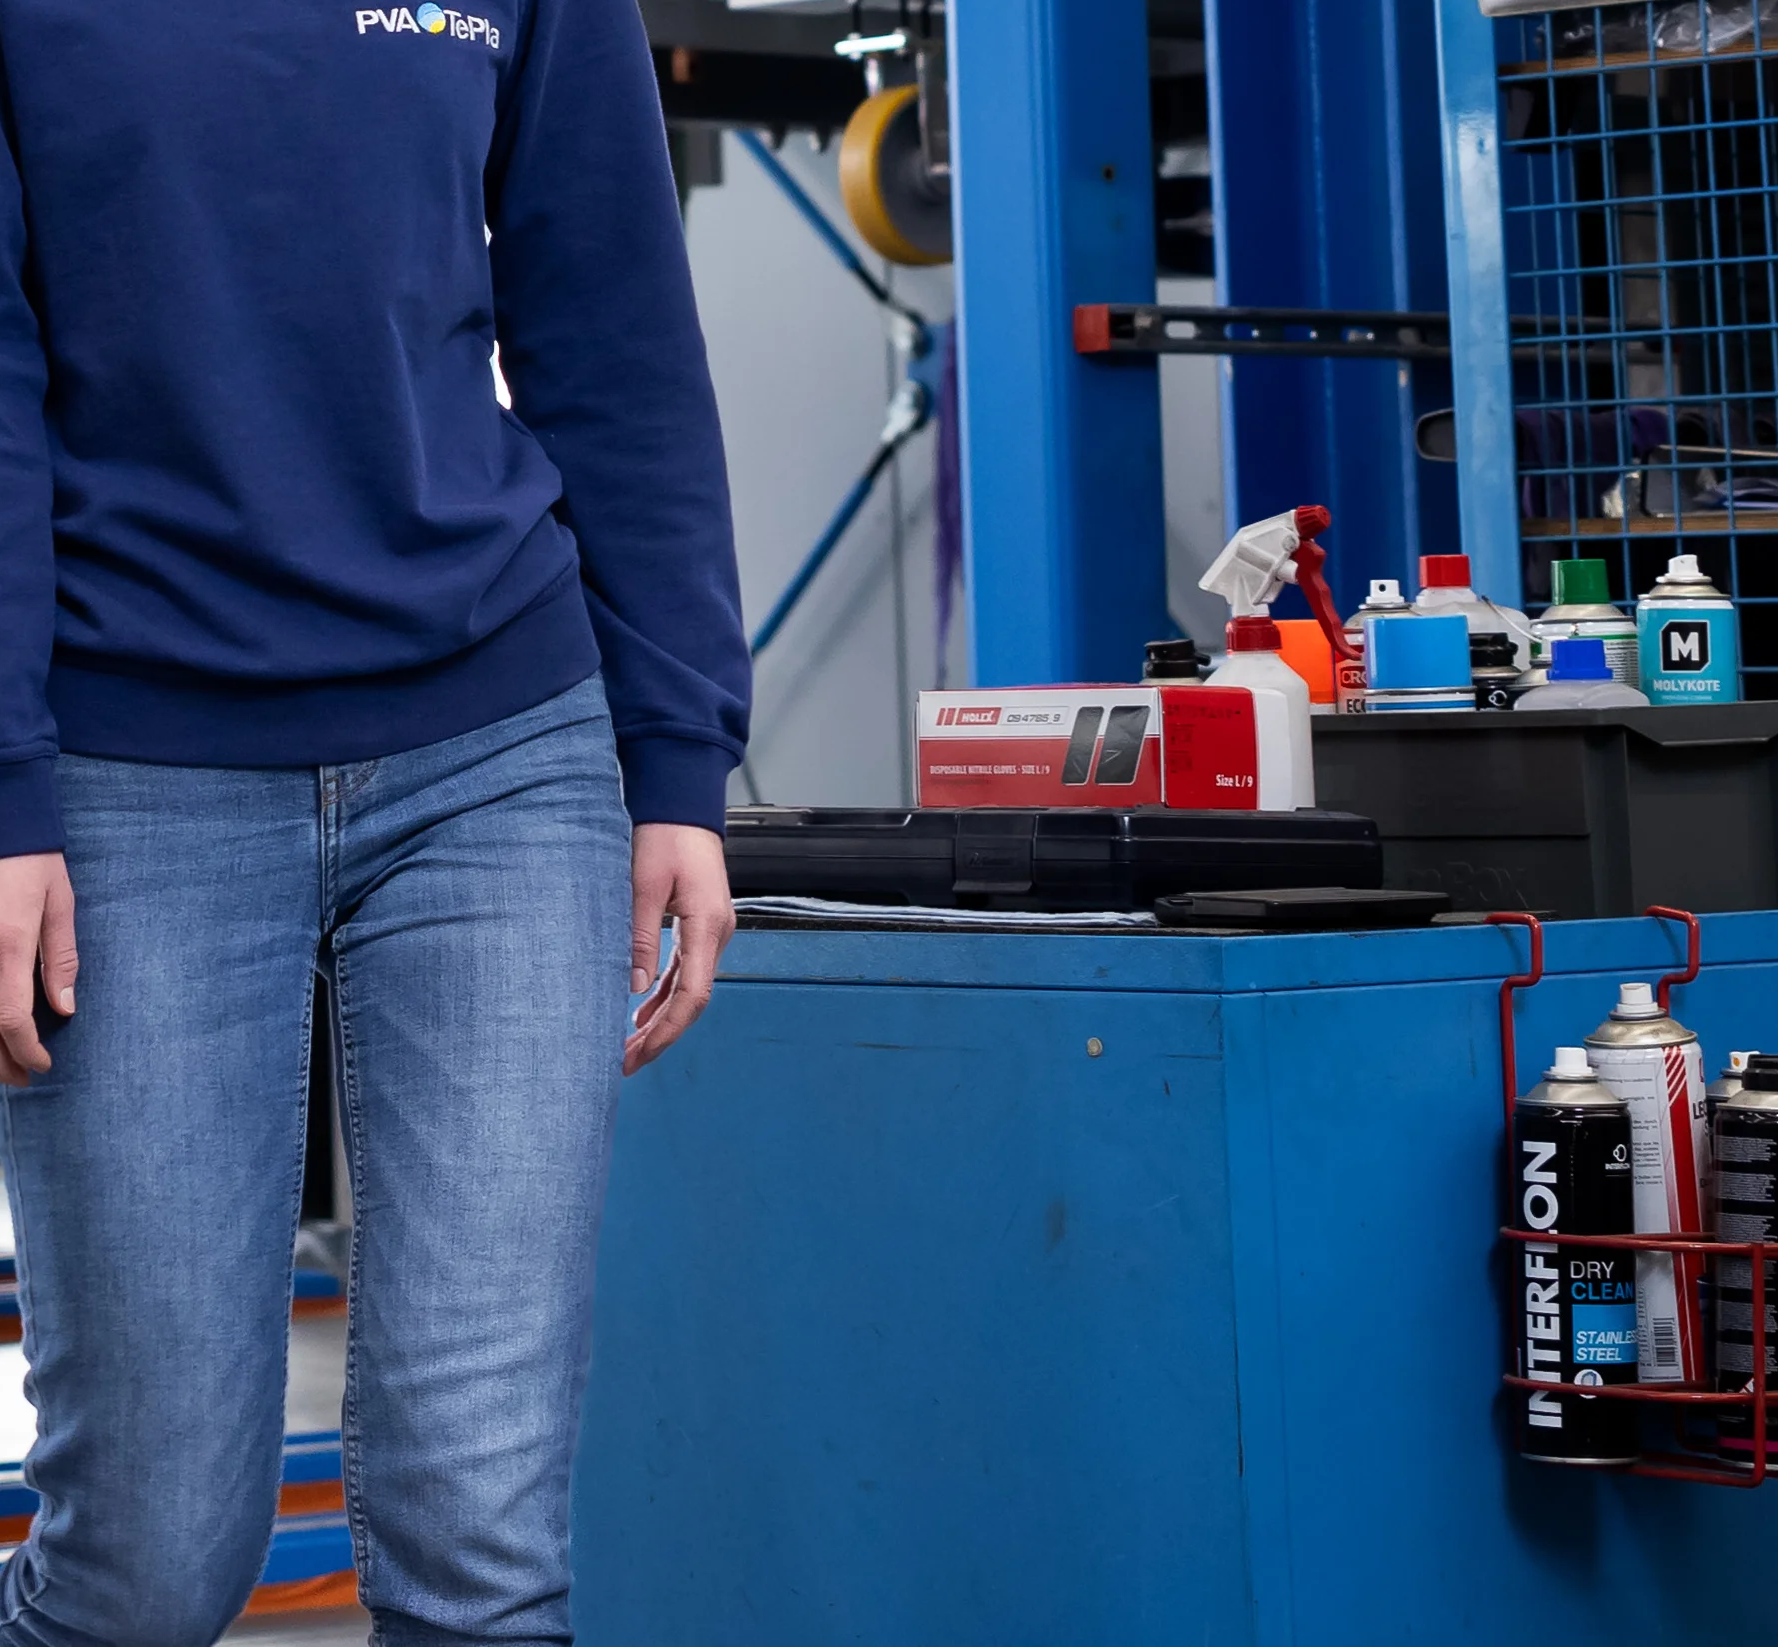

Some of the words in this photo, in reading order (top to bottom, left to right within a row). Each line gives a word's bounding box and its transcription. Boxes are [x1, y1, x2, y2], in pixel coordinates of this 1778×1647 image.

[355, 7, 420, 34] PVA
[443, 9, 500, 49] TePla
[1670, 631, 1700, 662] M
[1652, 678, 1721, 693] MOLYKOTE
[962, 710, 995, 723] HOLEX
[930, 765, 967, 775] DISPOSABLE
[968, 765, 992, 775] NITRILE
[993, 765, 1017, 775] GLOVES
[1021, 765, 1036, 775] SIZE
[1216, 774, 1233, 787] Size
[1570, 1261, 1614, 1279] DRY
[1522, 1140, 1563, 1428] INTERFLON
[1571, 1281, 1634, 1300] CLEAN
[1576, 1347, 1622, 1361] STEEL
